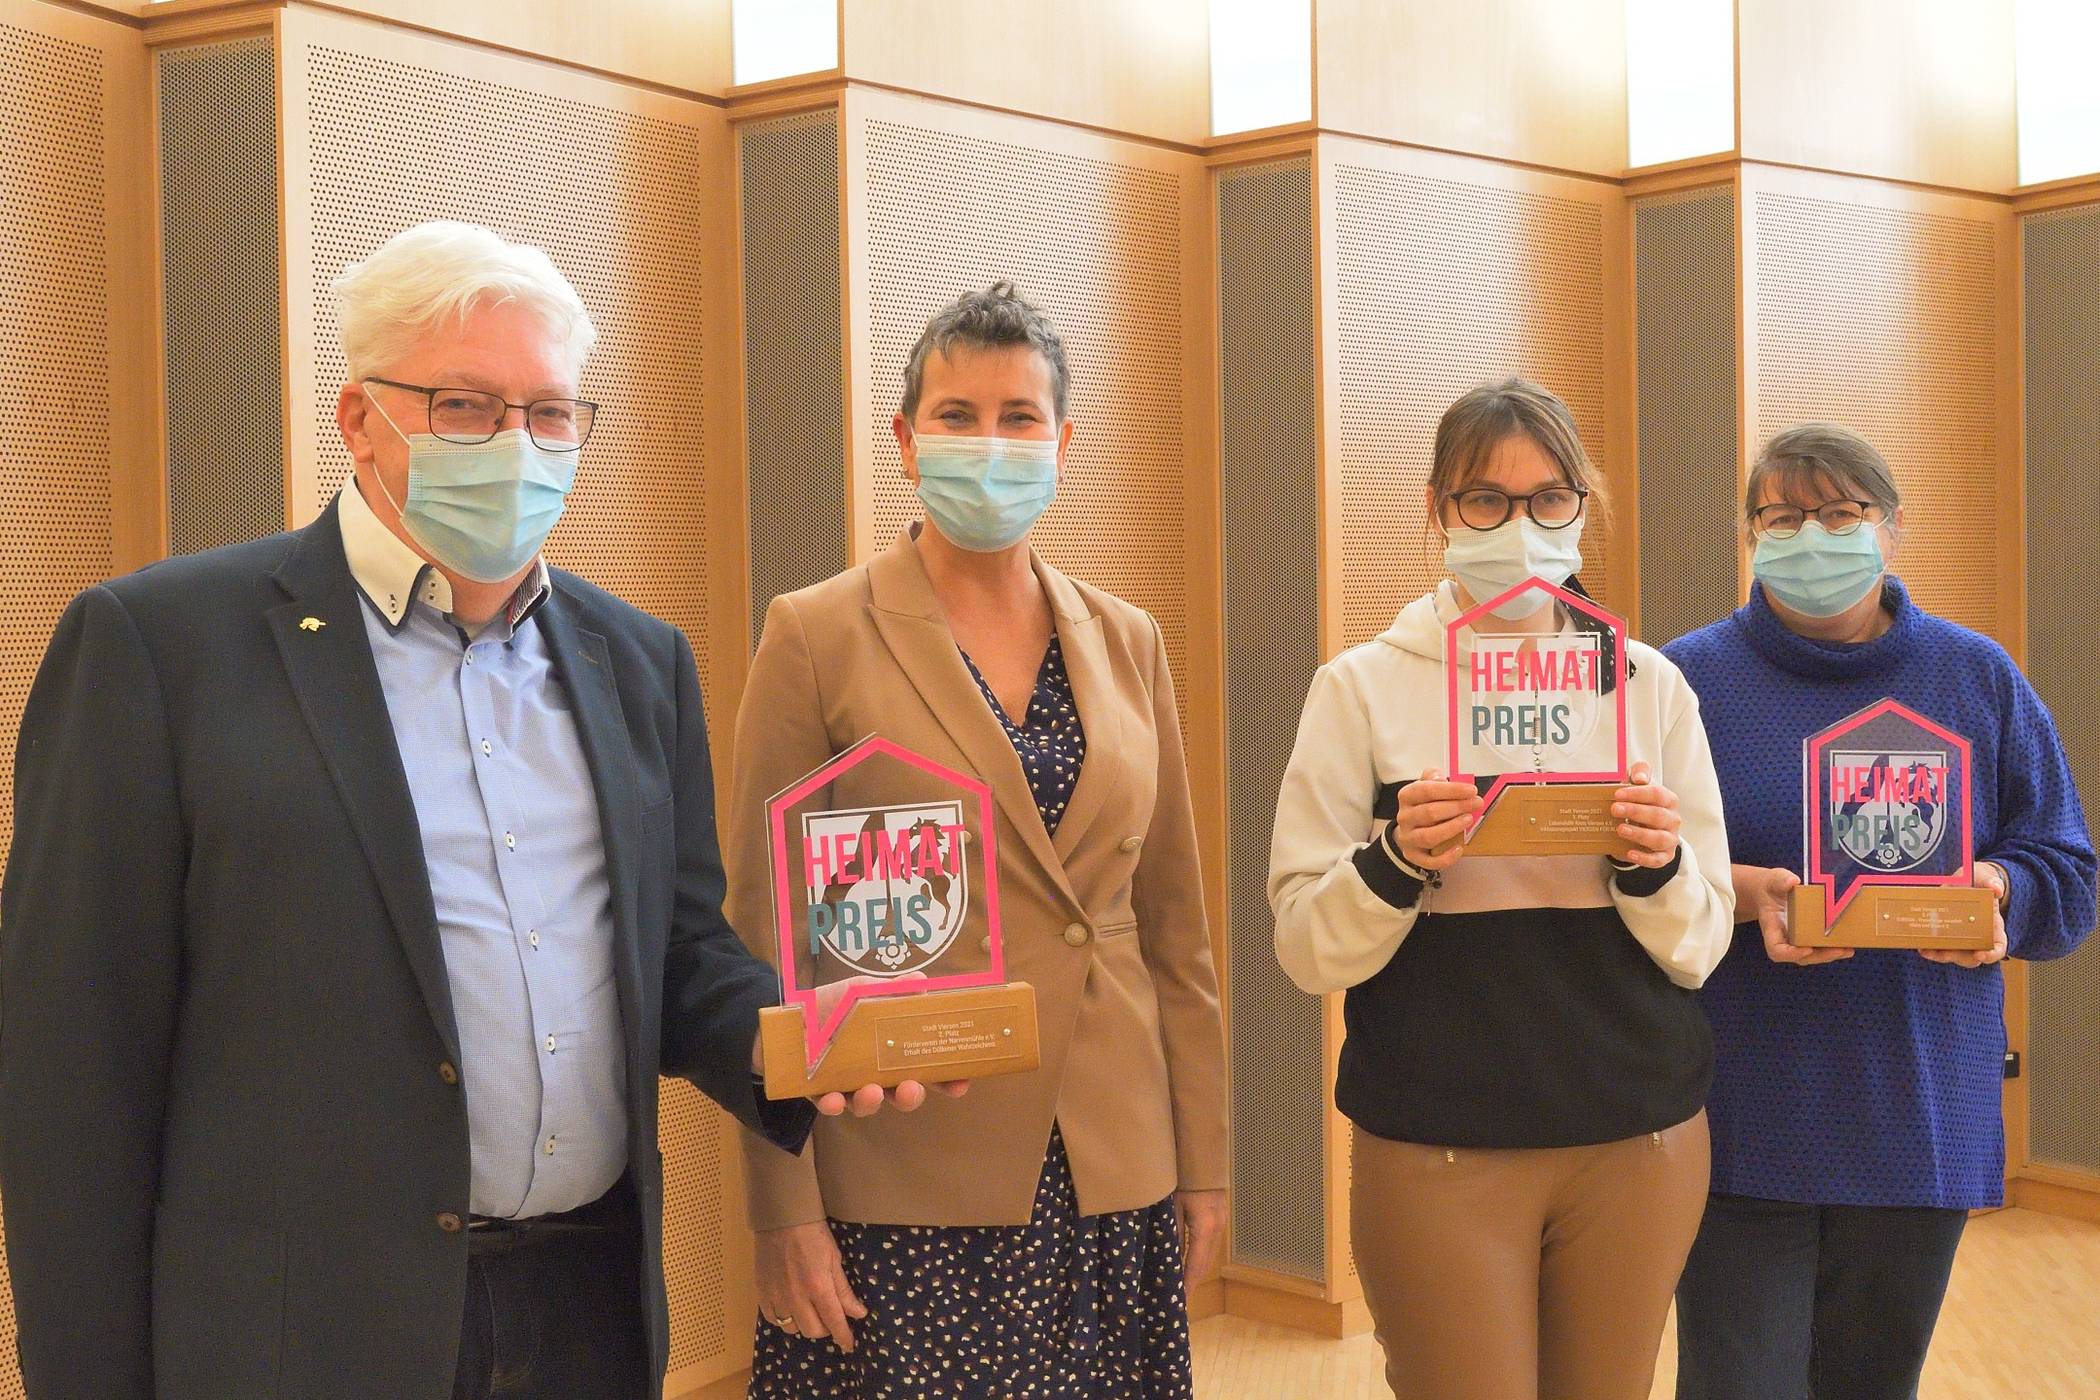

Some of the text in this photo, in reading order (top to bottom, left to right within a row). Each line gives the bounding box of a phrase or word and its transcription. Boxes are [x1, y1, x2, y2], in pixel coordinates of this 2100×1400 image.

[1471, 650, 1601, 692] HEIMAT
[1472, 704, 1570, 746] PREIS
[1831, 767, 1950, 804] HEIMAT
[1831, 814, 1921, 851] PREIS
[802, 824, 966, 887] HEIMAT
[807, 895, 933, 955] PREIS
